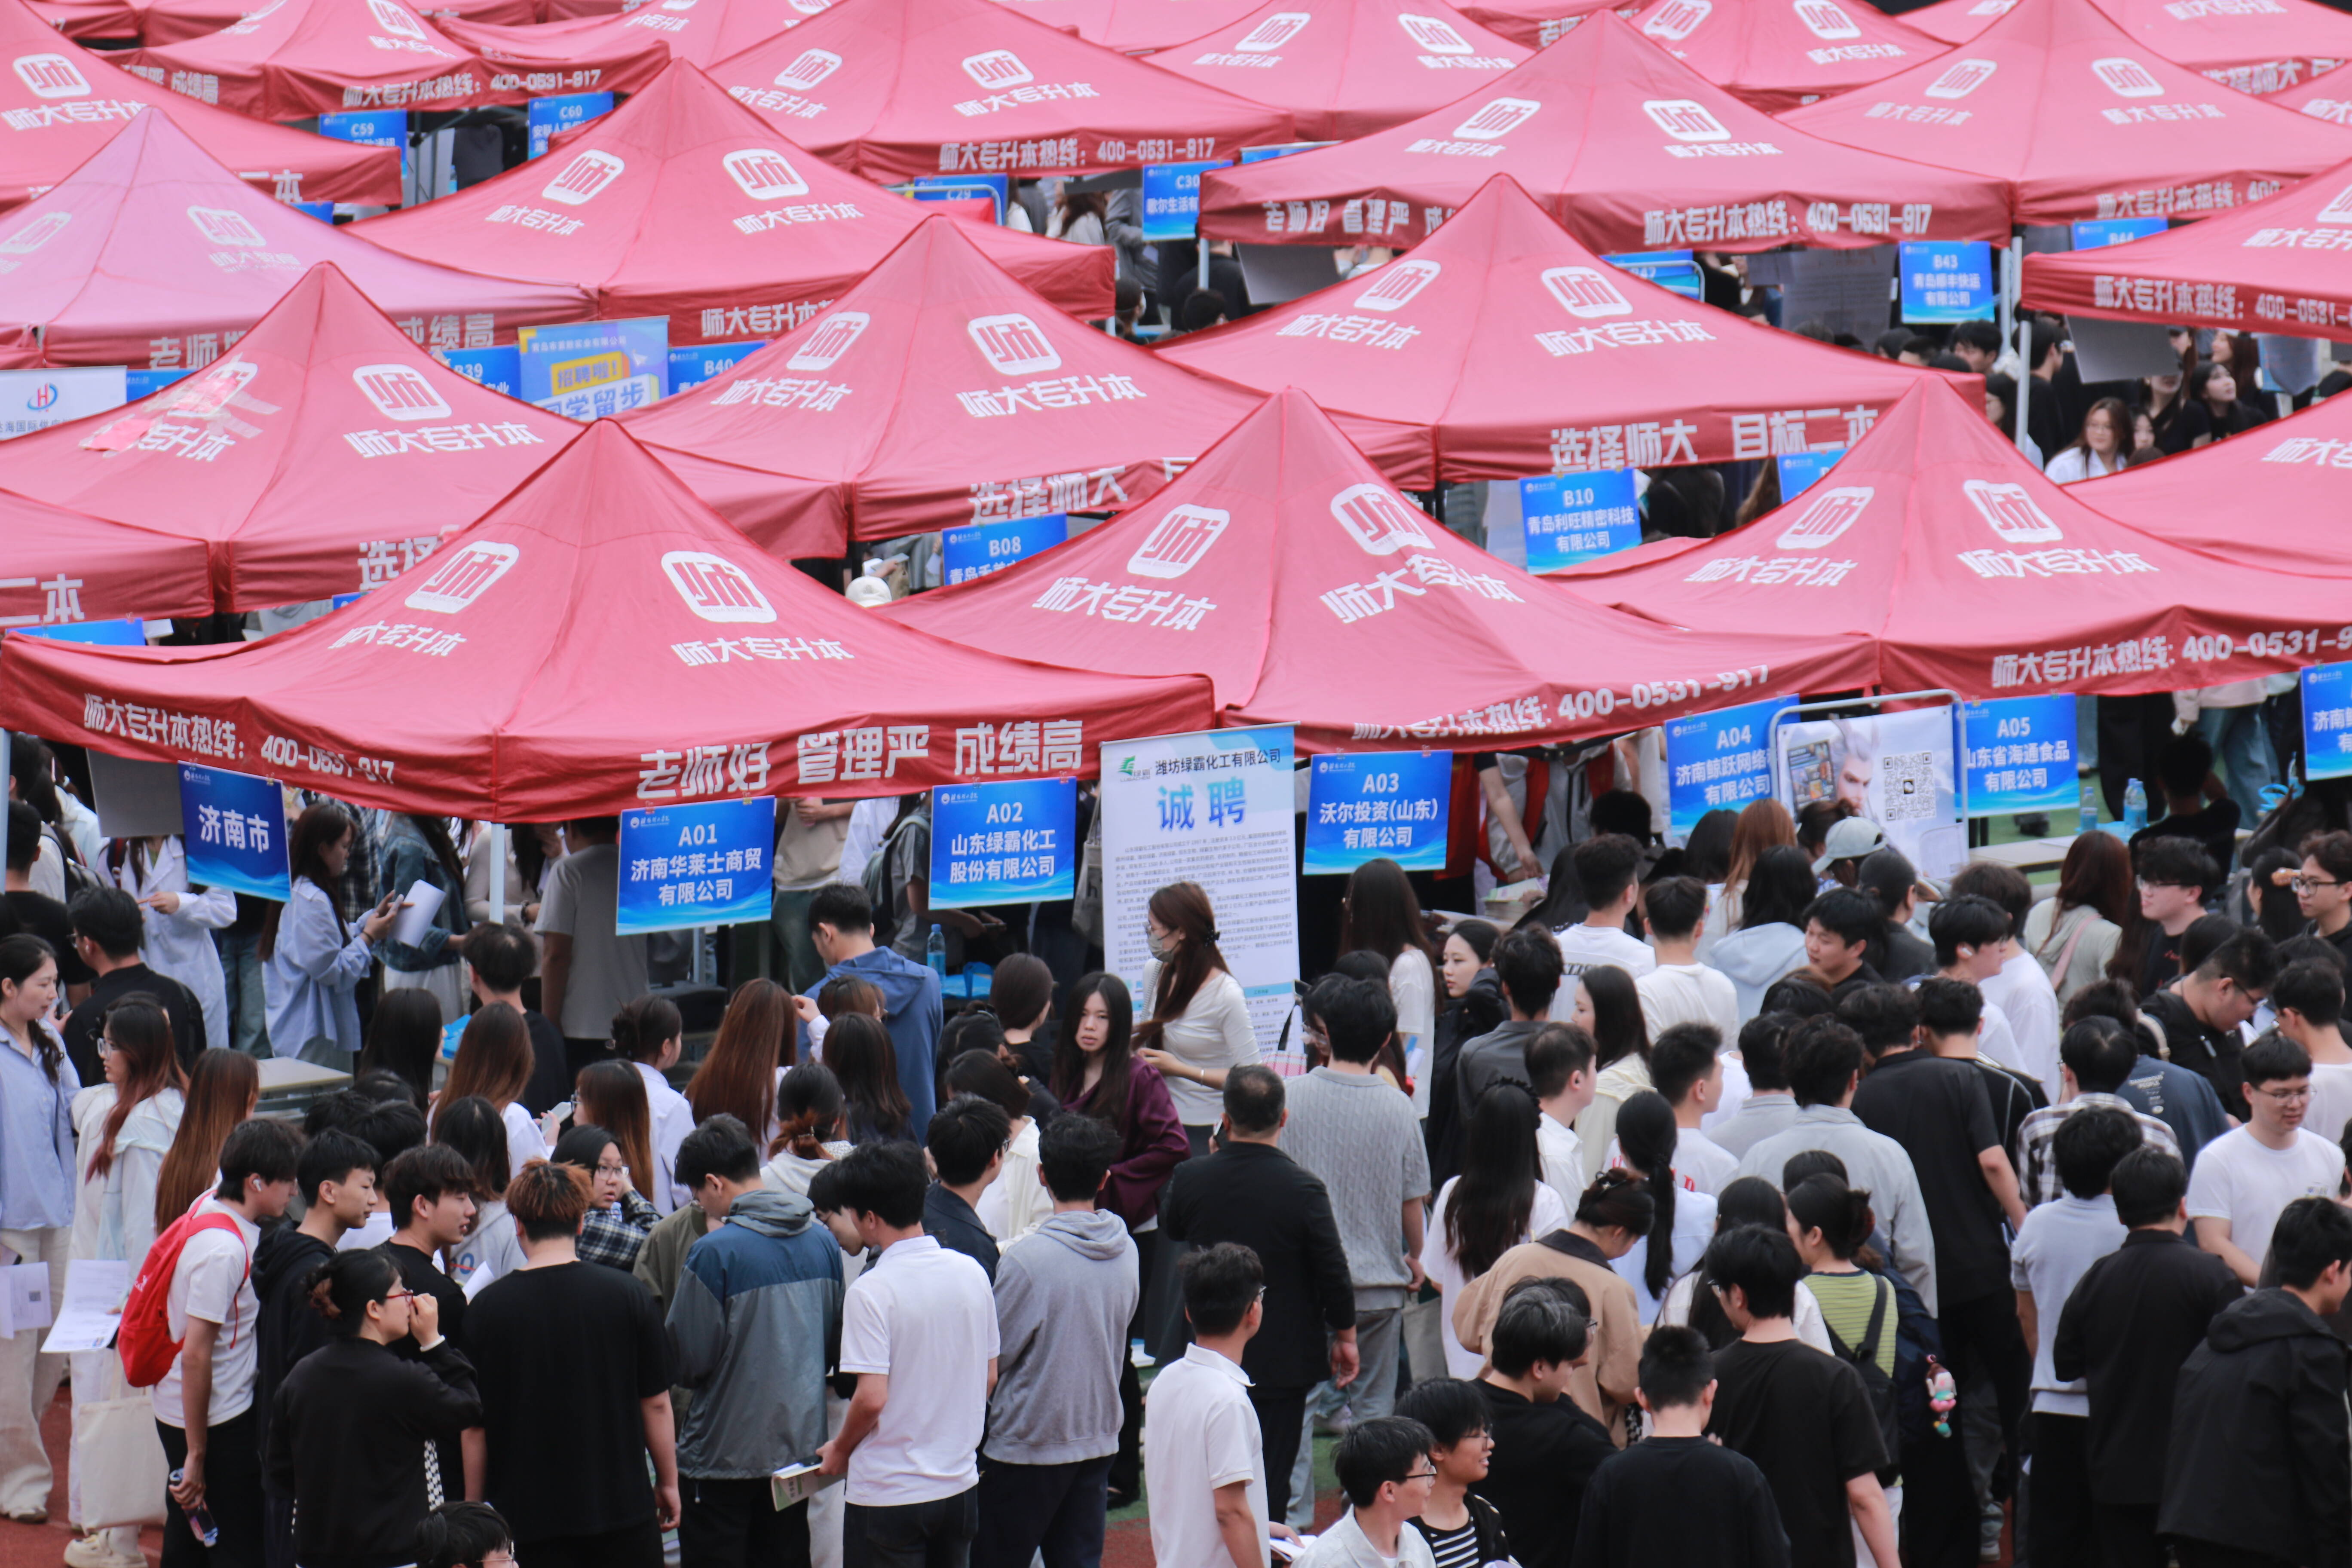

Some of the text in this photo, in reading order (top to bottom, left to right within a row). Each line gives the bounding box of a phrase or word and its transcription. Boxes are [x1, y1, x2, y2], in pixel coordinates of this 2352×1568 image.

[1417, 55, 1518, 70] 师大专升本
[1807, 43, 1906, 64] 师大专升本
[560, 105, 582, 119] C60
[728, 86, 828, 119] 师大专升本
[953, 82, 1099, 117] 师大专升本
[1864, 102, 1973, 126] 师大专升本
[2101, 103, 2226, 125] 师大专升本
[2301, 98, 2352, 126] 师大
[351, 123, 374, 137] C59
[1097, 138, 1215, 162] 400-0531-917
[1404, 138, 1506, 157] 师大专升本
[1663, 142, 1783, 158] 师大专升本
[947, 189, 971, 200] C29
[1176, 175, 1200, 190] C30
[486, 205, 584, 236] 师大专升本
[733, 202, 864, 235] 师大专升本
[1262, 200, 1329, 233] 老师好
[1343, 199, 1409, 236] 管理严
[1807, 203, 1932, 234] 400-0531-917
[2110, 232, 2134, 246] B44
[1933, 254, 1958, 270] B43
[1925, 291, 1970, 306] 有限公司
[2255, 294, 2352, 328] 400-0531-
[701, 300, 834, 337] 师大专升本
[1275, 314, 1421, 350] 师大专升本
[1534, 319, 1718, 357] 师大专升本
[704, 358, 733, 376] B40
[710, 377, 853, 411] 师大专升本
[956, 373, 1147, 418] 师大专升本
[138, 423, 236, 461] 专升本
[344, 421, 544, 458] 师大专升本
[1550, 419, 1698, 473] 选择师大
[968, 466, 1127, 524] 选择师大
[1563, 487, 1594, 507] B10
[1527, 506, 1636, 536] 青岛利旺精密科技
[989, 536, 1021, 557] B08
[1556, 530, 1610, 554] 有限公司
[358, 524, 460, 591] 选择
[1684, 555, 1858, 586] 师大专升本
[1957, 548, 2160, 578] 师大专升本
[1319, 553, 1526, 623] 师大专升本
[1032, 576, 1217, 631] 师大专升本
[328, 620, 467, 657] 师大专升本
[671, 636, 855, 666] 师大专升本
[1559, 665, 1769, 721] 400-0531-917
[1717, 724, 1752, 750] A04
[1997, 717, 2031, 738] A05
[261, 734, 394, 785] 400-0531-917
[636, 719, 1083, 799] 老师好 管理严 成绩高
[1155, 747, 1281, 775] 潍坊绿霸化工有限公司
[1966, 740, 2070, 768] 山东省海通食品
[1362, 773, 1400, 793] A03
[1705, 774, 1771, 805] 有限公司
[1985, 768, 2047, 793] 有限公司
[986, 802, 1023, 824] A02
[197, 803, 270, 853] 济南市
[678, 824, 717, 847] A01
[951, 829, 1056, 856] 山东绿霸化工
[1343, 827, 1412, 850] 有限公司
[631, 848, 762, 882] 济南华莱士商贸
[949, 855, 1056, 884] 股份有限公司
[658, 878, 732, 906] 有限公司
